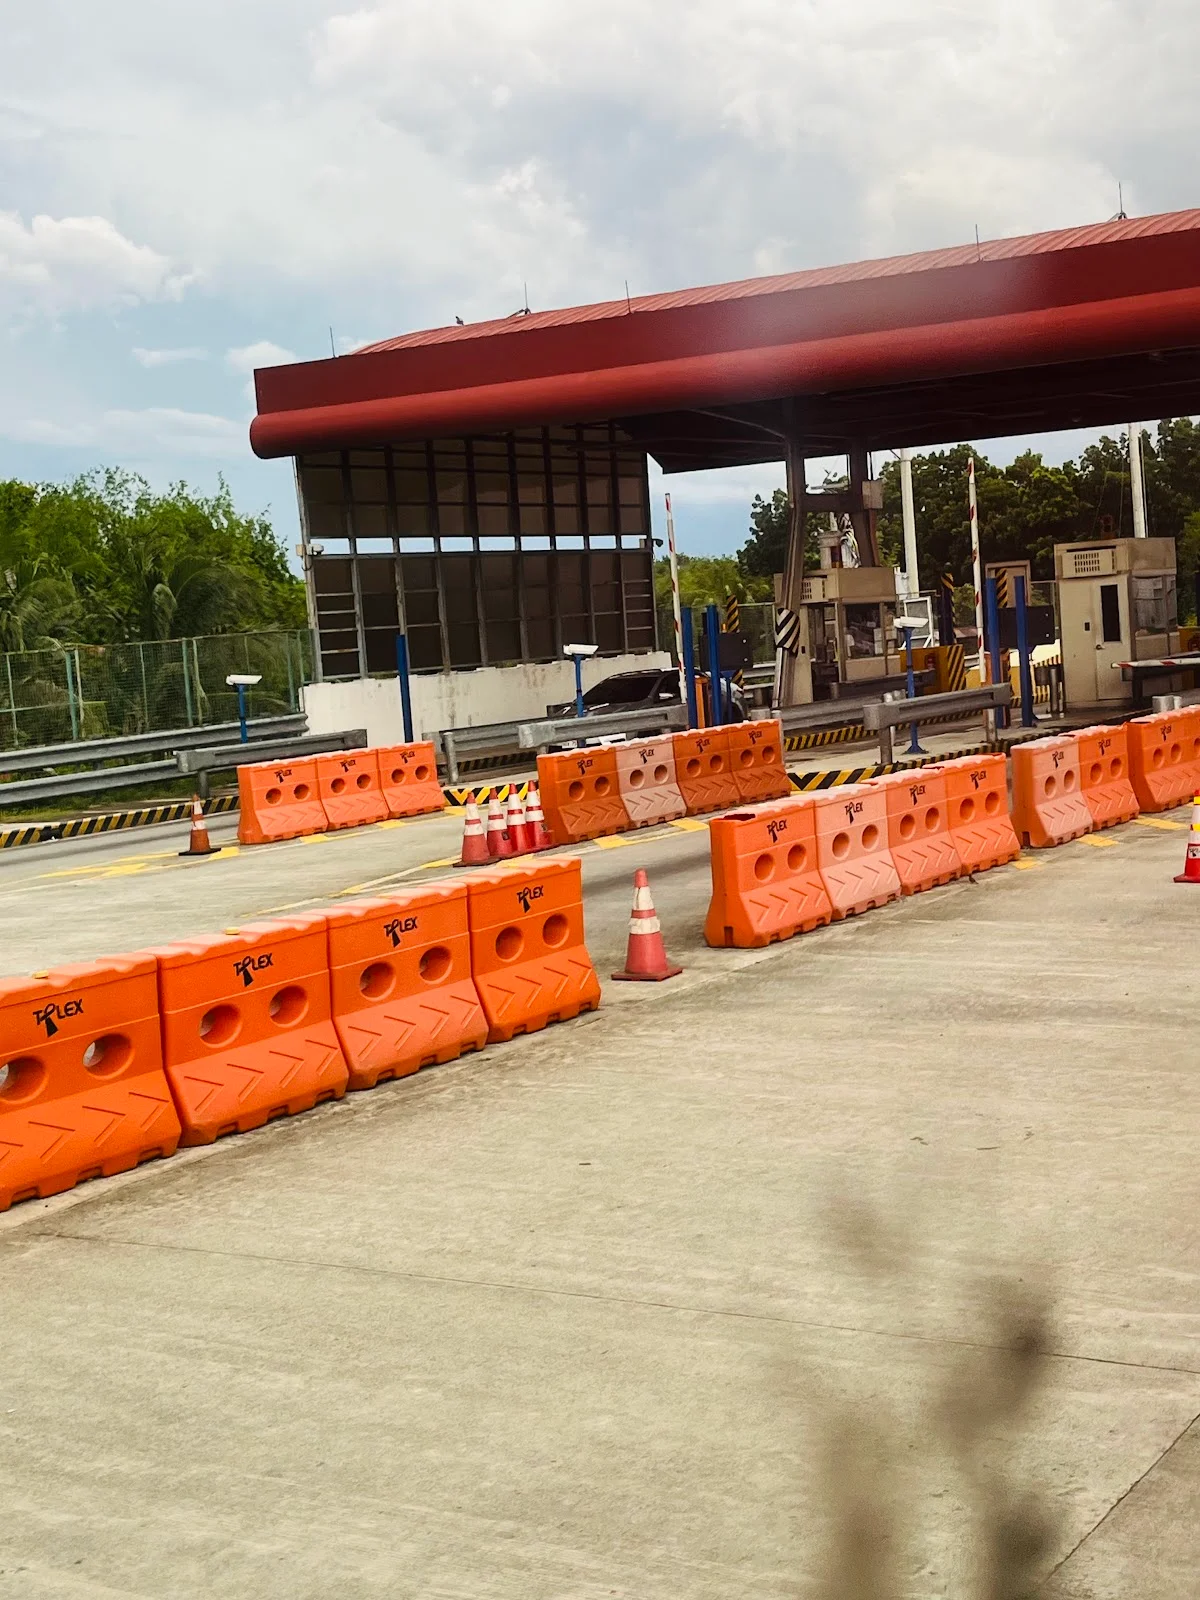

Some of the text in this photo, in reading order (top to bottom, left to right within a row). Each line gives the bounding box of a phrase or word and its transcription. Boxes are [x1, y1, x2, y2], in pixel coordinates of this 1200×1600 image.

[639, 749, 655, 764] TPLEX
[910, 785, 925, 805] TPLEX
[845, 802, 863, 824] TPLEX
[767, 820, 788, 844] TPLEX
[516, 886, 544, 914] TPLEX
[384, 917, 417, 947] TPLEX
[233, 953, 274, 987] TPLEX
[33, 999, 83, 1037] TPLEX
